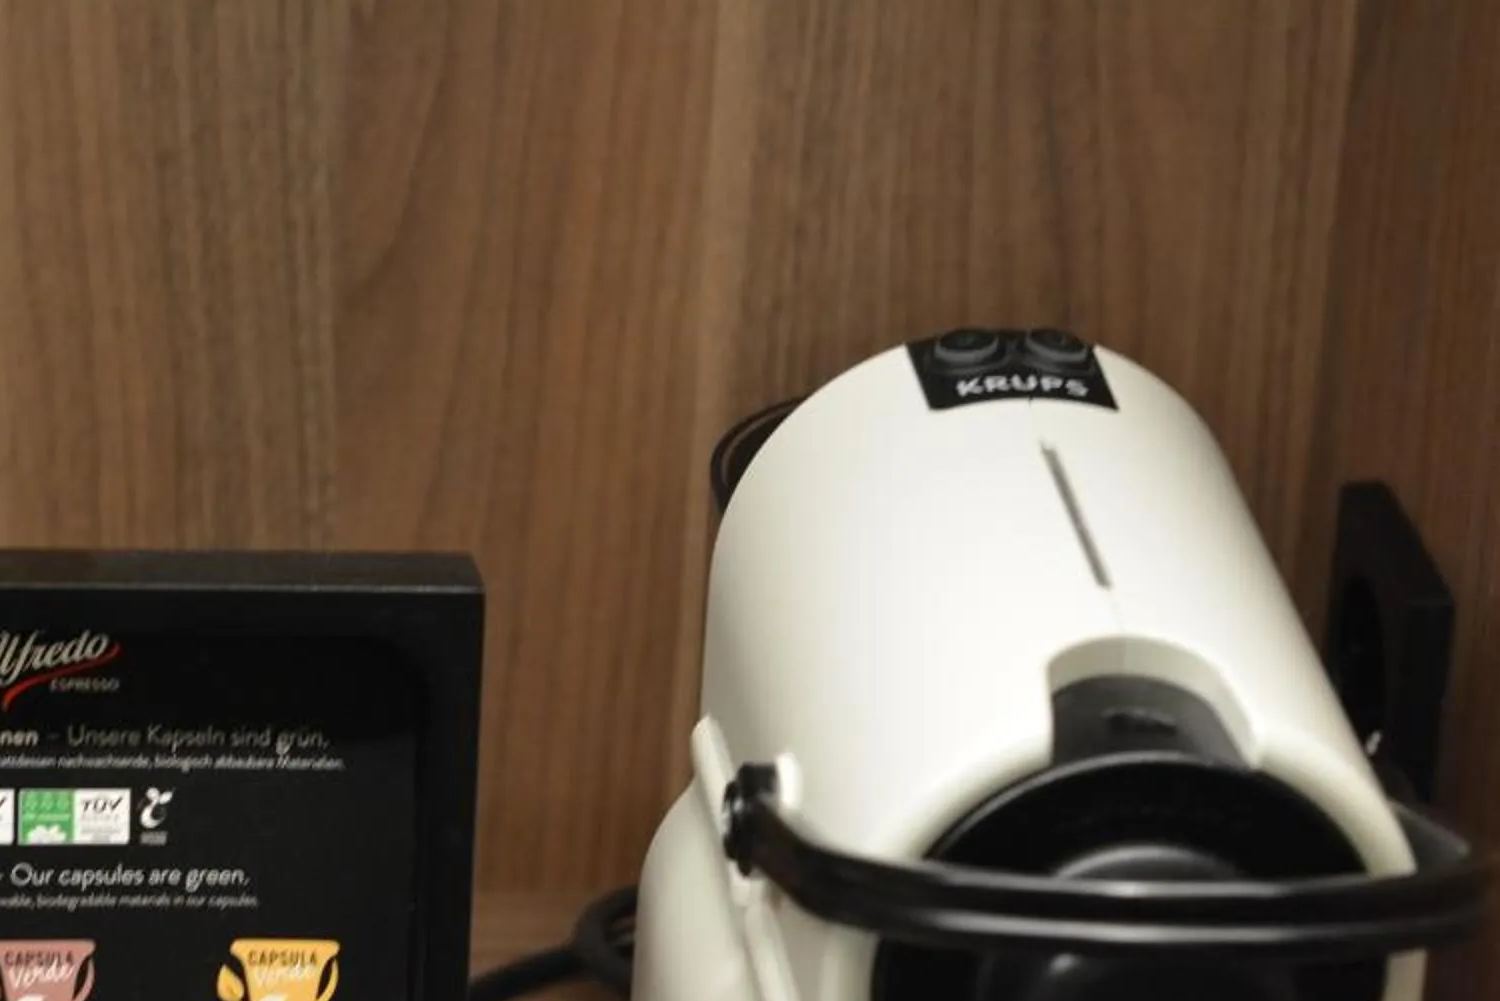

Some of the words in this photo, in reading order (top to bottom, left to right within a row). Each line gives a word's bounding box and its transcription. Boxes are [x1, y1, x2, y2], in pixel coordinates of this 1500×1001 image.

[955, 373, 1089, 397] KRUPS
[67, 724, 141, 746] Unsere
[147, 724, 225, 753] Kapseln
[230, 726, 271, 746] sind
[81, 796, 122, 813] TÜV
[10, 862, 54, 886] Our
[58, 863, 144, 892] capsules
[149, 868, 182, 886] are
[4, 950, 75, 966] CAPSULA
[249, 950, 318, 967] CAPSULA
